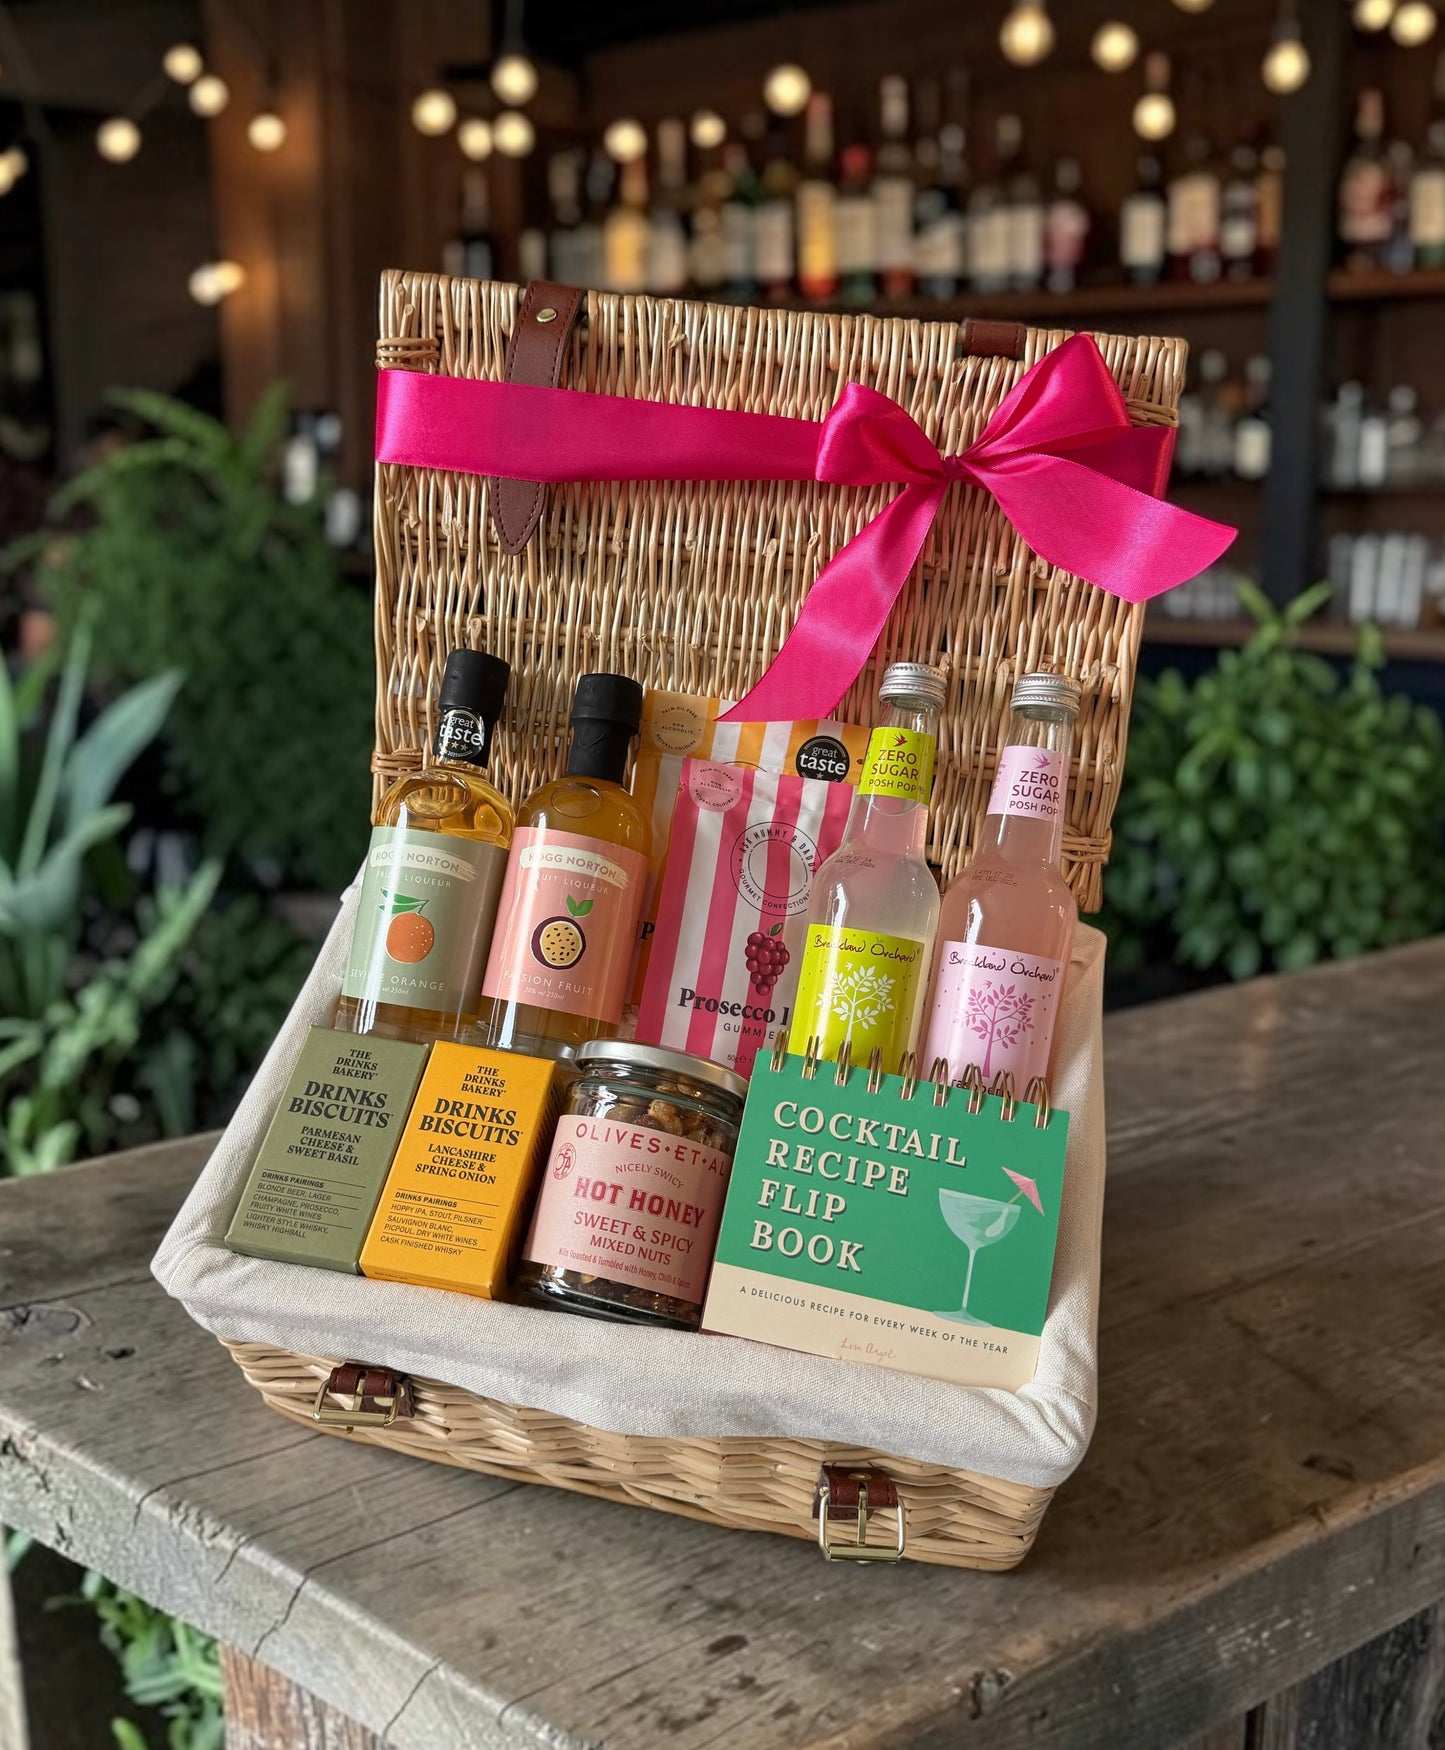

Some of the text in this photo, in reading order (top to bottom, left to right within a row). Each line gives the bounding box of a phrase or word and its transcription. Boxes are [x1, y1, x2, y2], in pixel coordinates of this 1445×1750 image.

[450, 716, 474, 729] great
[661, 706, 676, 714] PALM
[686, 708, 698, 719] FREE
[440, 723, 482, 746] taste
[662, 726, 694, 735] ALCOHOLIC
[656, 733, 697, 751] NATURAL COLOURS
[811, 746, 838, 759] great
[878, 749, 917, 765] ZERO
[800, 753, 846, 776] taste
[871, 764, 919, 781] SUGAR
[722, 772, 734, 782] FREE
[868, 778, 916, 792] POSH POP
[1020, 770, 1059, 788] ZERO
[700, 782, 732, 793] ALCOHOLIC
[1012, 784, 1060, 804] SUGAR
[694, 788, 734, 808] NATURAL COLOURS
[1009, 800, 1058, 816] POSH POP
[739, 838, 753, 854] ASK
[752, 828, 788, 840] MUMMY
[799, 842, 817, 873] DADDY
[375, 850, 460, 873] HOG NORTON
[566, 856, 618, 879] NORTON
[404, 874, 452, 888] LIQUEUR
[564, 878, 609, 895] LIQUEUR
[738, 868, 811, 910] GOURMET CONFECTIONE
[814, 934, 916, 963] Brekland Orchard
[350, 968, 445, 992] SEVIE ORANGE
[1010, 962, 1056, 982] Orchard
[503, 970, 593, 996] PASION FRUIT
[678, 987, 776, 1024] Prosecco
[723, 1022, 779, 1040] GUMMIE
[336, 1056, 378, 1071] DRINKS
[350, 1048, 372, 1060] THE
[332, 1066, 376, 1080] BAKERY
[464, 1074, 506, 1088] DRINKS
[476, 1065, 500, 1077] THE
[304, 1080, 388, 1108] DRINKS
[460, 1083, 504, 1098] BAKERY
[288, 1096, 390, 1128] BISCUITS
[433, 1098, 517, 1126] DRINKS
[301, 1126, 362, 1144] PARMESAN
[418, 1114, 520, 1146] BISCUITS
[575, 1122, 662, 1154] OLIVES
[773, 1100, 967, 1168] COCKTAIL
[287, 1144, 359, 1166] SWEET BASIL
[300, 1136, 354, 1154] CHEESE &
[428, 1143, 497, 1163] LANCASHIRE
[432, 1155, 486, 1172] CHEESE &
[765, 1138, 910, 1196] RECIPE
[262, 1171, 324, 1188] DRINKS PAIRINGS
[415, 1163, 497, 1185] SPRING ONION
[615, 1162, 684, 1190] NICELY SWICY
[257, 1182, 286, 1194] BLONDE
[308, 1191, 332, 1202] LAGER
[394, 1192, 458, 1208] DRINKS PAIRINGS
[757, 1178, 847, 1223] FLIP
[250, 1201, 322, 1220] FRUITY WHITE WINES
[300, 1202, 340, 1216] PROSECCO,
[574, 1176, 706, 1229] HOT HONEY
[246, 1212, 276, 1224] LIGHTER
[276, 1218, 298, 1228] STYLE
[386, 1215, 454, 1234] SAUVIGNON BLANC,
[390, 1203, 484, 1226] HOPPY IPA, STOUT, PILSNER
[242, 1220, 306, 1238] WHISKY HIGHBALL
[416, 1228, 432, 1238] DRY
[432, 1231, 454, 1242] WHITE
[454, 1235, 478, 1246] WINES
[573, 1210, 695, 1254] SWEET & SPICY
[380, 1235, 464, 1256] CASK FINISHED WHISKY
[590, 1234, 672, 1266] MIXED NUTS
[750, 1219, 864, 1274] BOOK
[559, 1248, 569, 1256] Kiln
[570, 1248, 592, 1262] Roasted
[592, 1256, 598, 1264] &
[598, 1256, 624, 1271] Tumbled
[624, 1263, 638, 1274] with
[639, 1266, 658, 1281] Honey,
[751, 1288, 806, 1308] DELICIOUS
[810, 1302, 845, 1317] RECIPE
[849, 1311, 869, 1322] FOR
[873, 1316, 905, 1330] EVERY
[909, 1325, 938, 1338] WEEK
[942, 1332, 956, 1342] OF
[960, 1336, 978, 1348] THE
[982, 1341, 1008, 1354] YEAR
